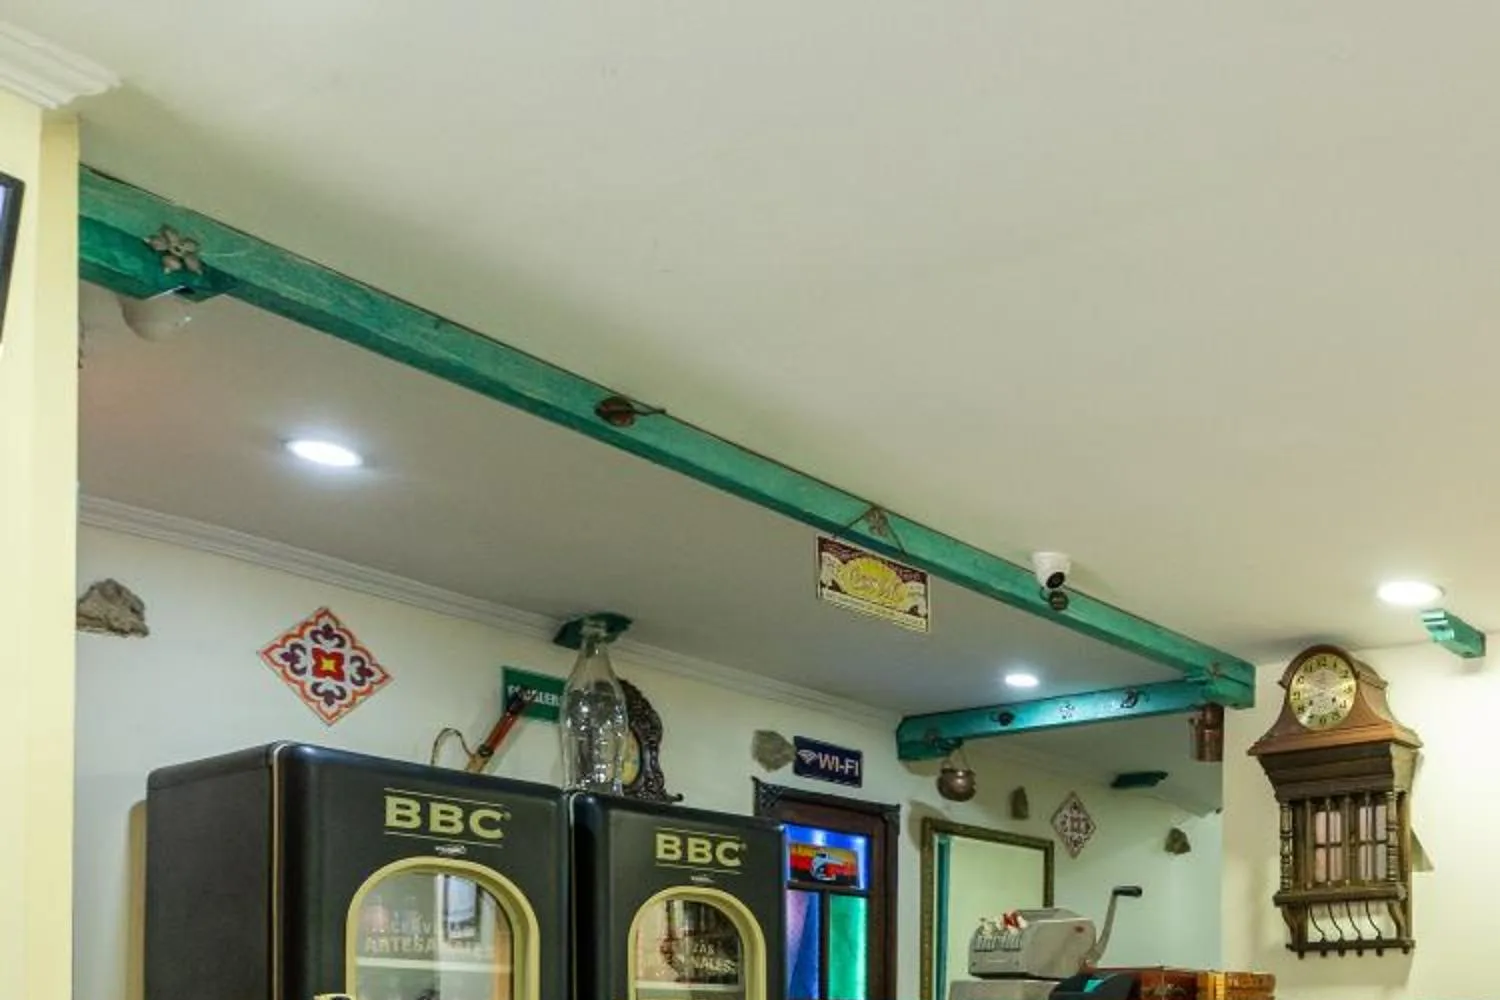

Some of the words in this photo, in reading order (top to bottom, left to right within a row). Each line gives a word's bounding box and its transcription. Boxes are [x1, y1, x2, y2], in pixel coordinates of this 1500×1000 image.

[817, 751, 859, 777] WI-FI
[384, 796, 504, 839] BBC
[656, 833, 742, 867] BBC
